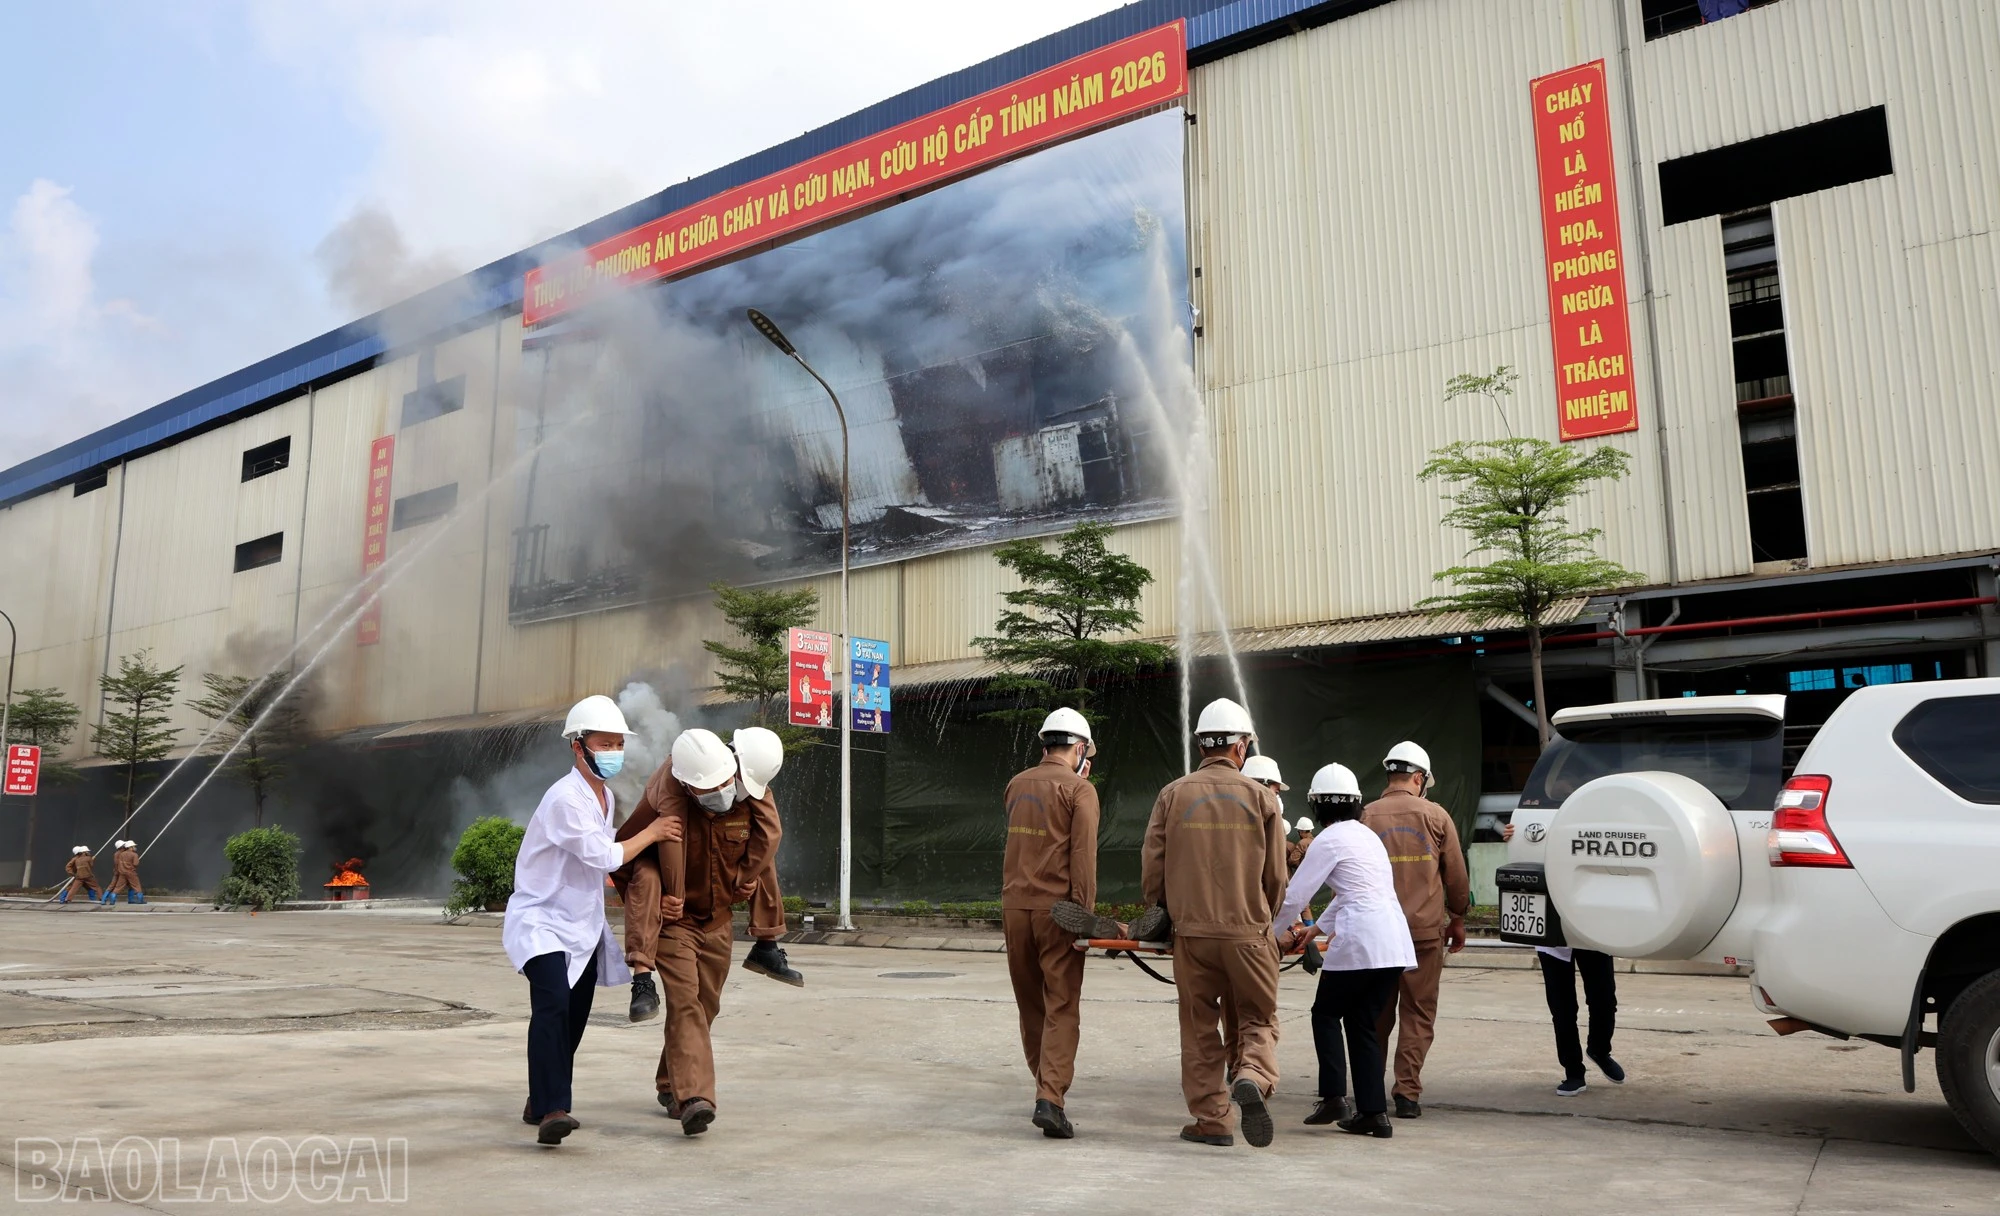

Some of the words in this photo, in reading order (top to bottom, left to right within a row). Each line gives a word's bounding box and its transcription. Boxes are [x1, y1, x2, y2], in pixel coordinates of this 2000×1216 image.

[1546, 82, 1592, 114] CHÁY
[1560, 112, 1585, 143] NỔ
[1564, 149, 1587, 176] LÀ
[534, 279, 564, 308] THỰC
[596, 241, 650, 282] PHƯƠNG
[655, 230, 675, 261] ÁN
[679, 213, 719, 251] CHỮA
[723, 199, 764, 239] CHÁY
[769, 187, 789, 220] VÀ
[794, 173, 827, 211] CỨU
[833, 157, 874, 199] NẠN,
[880, 134, 917, 180] CỨU
[923, 125, 948, 167] HỘ
[955, 107, 995, 153] CẤP
[1001, 95, 1048, 137] TỈNH
[1053, 74, 1104, 118] NĂM
[1111, 51, 1166, 98] 2026
[1555, 179, 1602, 212] HIỂM
[1561, 219, 1603, 247] HỌA,
[1553, 249, 1616, 281] PHÒNG
[1562, 286, 1614, 315] NGỪA
[1579, 319, 1603, 347] LÀ
[1563, 354, 1624, 385] TRÁCH
[1566, 390, 1628, 420] NHIỆM
[377, 447, 386, 460] AN
[797, 632, 805, 650] 3
[804, 641, 814, 652] TAI
[814, 644, 829, 654] NẠN
[855, 641, 862, 658] 3
[1578, 830, 1602, 839] LAND
[1604, 831, 1647, 840] CRUISER
[1748, 821, 1769, 829] TX
[1571, 839, 1658, 859] PRADO
[1509, 874, 1538, 883] PRADO
[1511, 895, 1535, 914] 30E
[1502, 913, 1545, 935] 036.76
